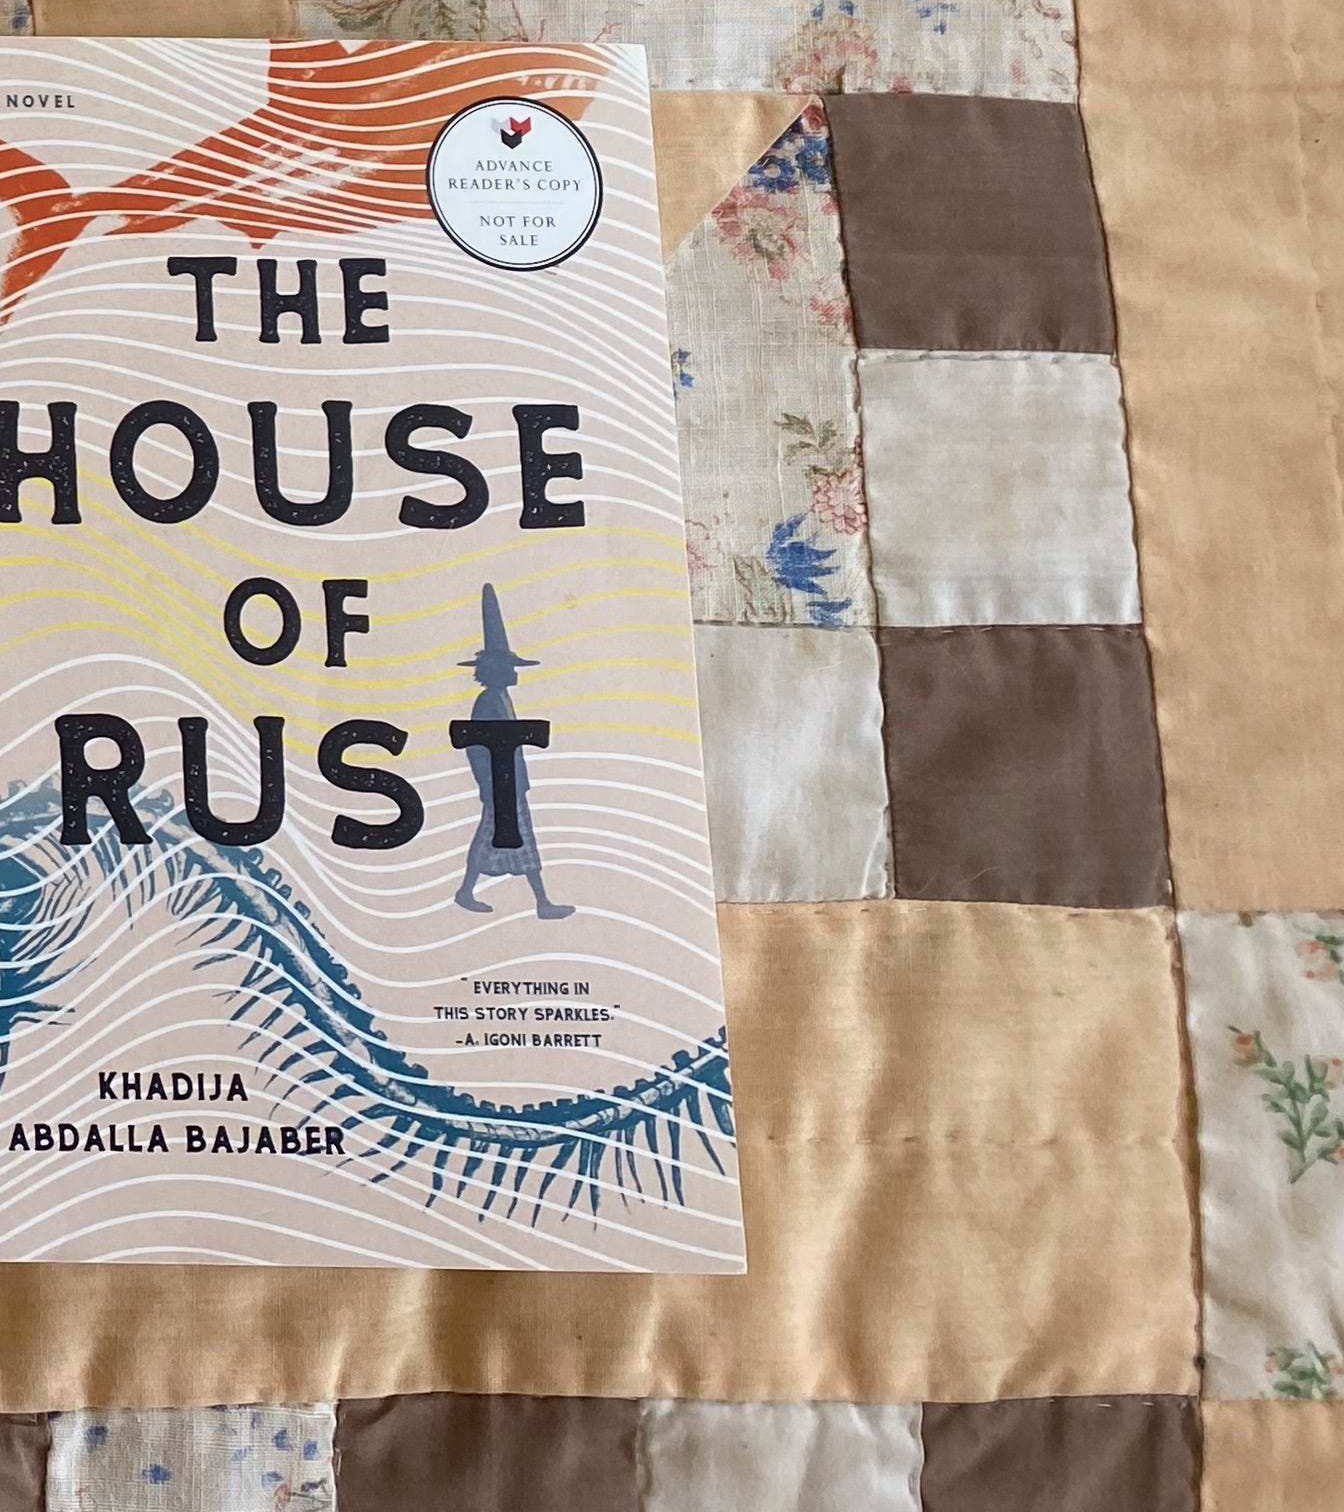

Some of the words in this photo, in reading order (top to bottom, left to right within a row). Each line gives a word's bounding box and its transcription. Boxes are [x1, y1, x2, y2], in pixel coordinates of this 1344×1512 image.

[6, 94, 76, 109] NOVEL
[475, 159, 553, 173] ADVANCE
[448, 177, 531, 190] READER’S
[537, 178, 581, 192] COPY
[480, 215, 516, 228] NOT
[523, 215, 556, 228] FOR
[499, 234, 539, 247] SALE
[167, 255, 391, 345] THE
[223, 576, 371, 668] OF
[54, 713, 551, 851] RUST
[574, 981, 590, 995] IN
[433, 1006, 469, 1020] THIS
[475, 1006, 528, 1021] STORY
[484, 1033, 527, 1047] IGONI
[532, 1033, 602, 1048] BARRETT
[97, 1071, 250, 1103] KHADIJA
[8, 1123, 178, 1154] ABDALLA
[185, 1125, 346, 1157] BAJABER
